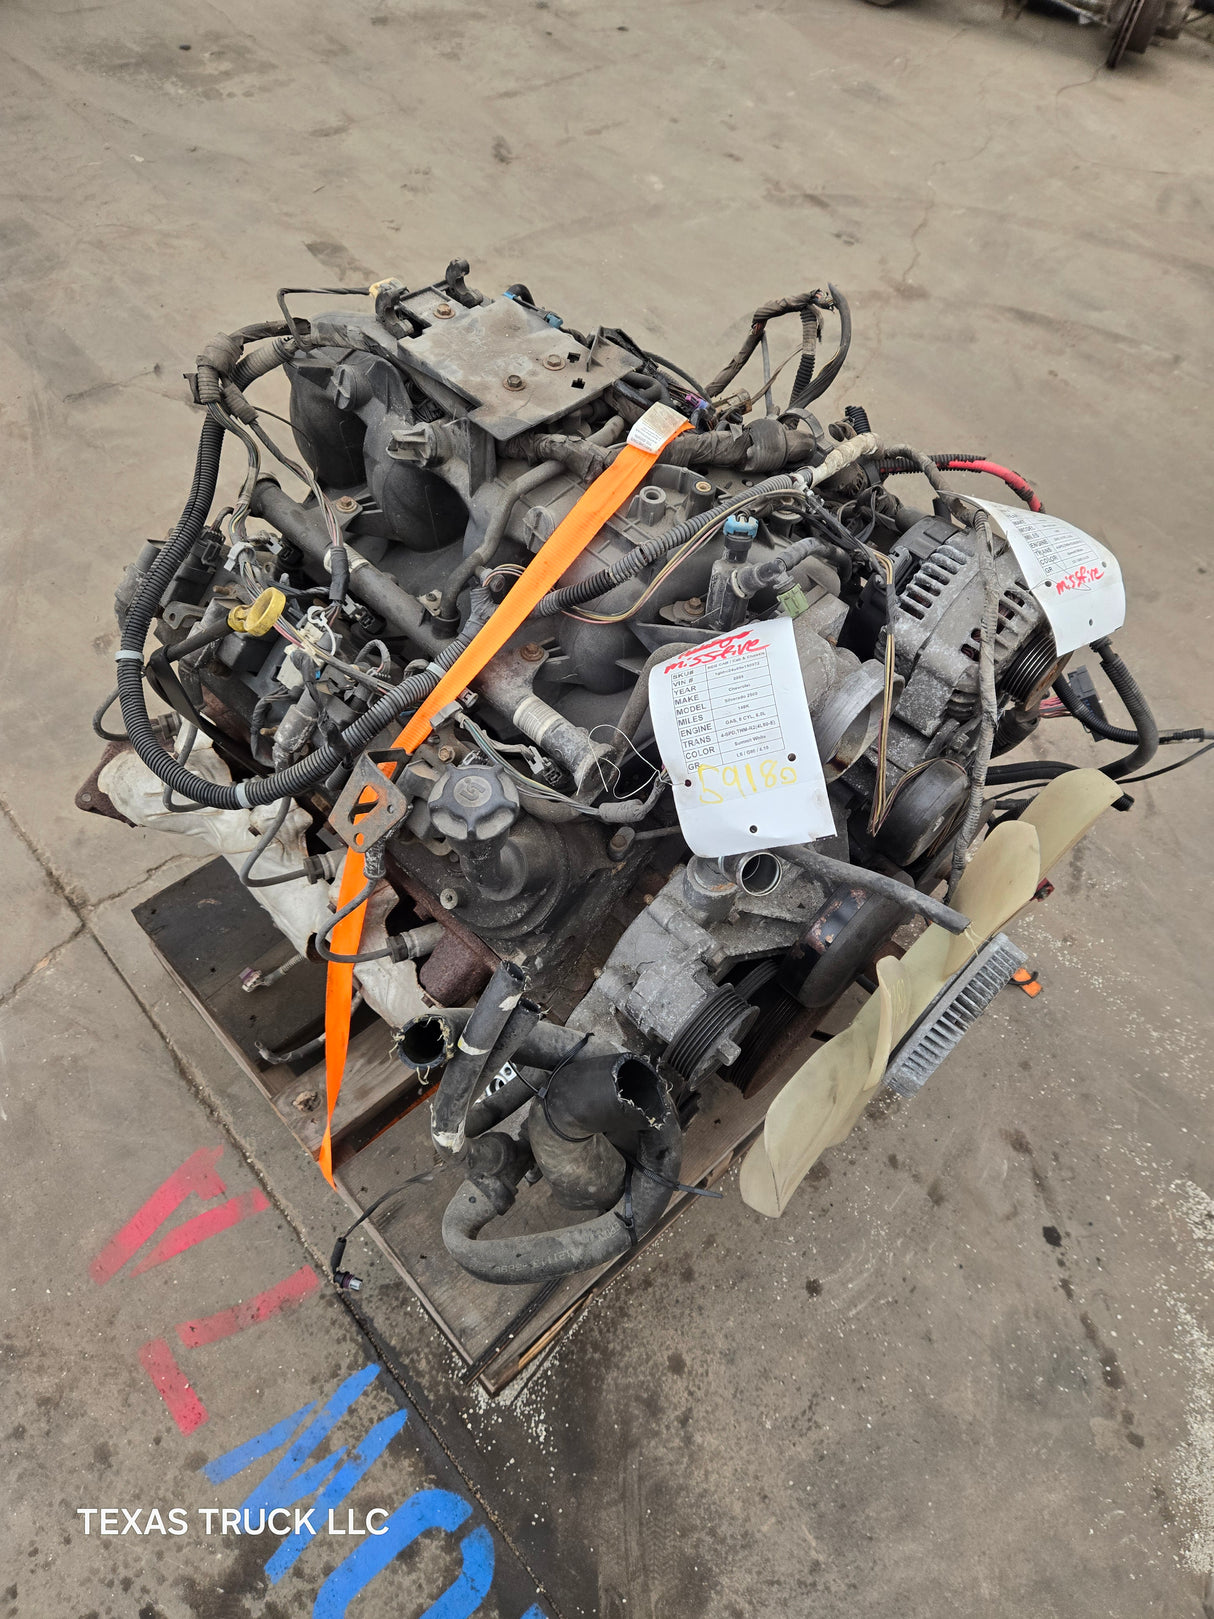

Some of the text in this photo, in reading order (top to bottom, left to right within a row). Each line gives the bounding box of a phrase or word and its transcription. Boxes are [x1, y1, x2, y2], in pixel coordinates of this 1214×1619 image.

[1039, 555, 1058, 566] COLOR
[672, 669, 694, 681] SKU#
[673, 680, 687, 688] VIN
[673, 685, 697, 696] YEAR
[675, 694, 700, 706] MAKE
[676, 703, 707, 716] MODEL
[678, 714, 704, 727] MILES
[680, 723, 713, 738] ENGINE
[683, 735, 712, 749] TRANS
[685, 746, 716, 760] COLOR
[697, 759, 797, 804] 59180
